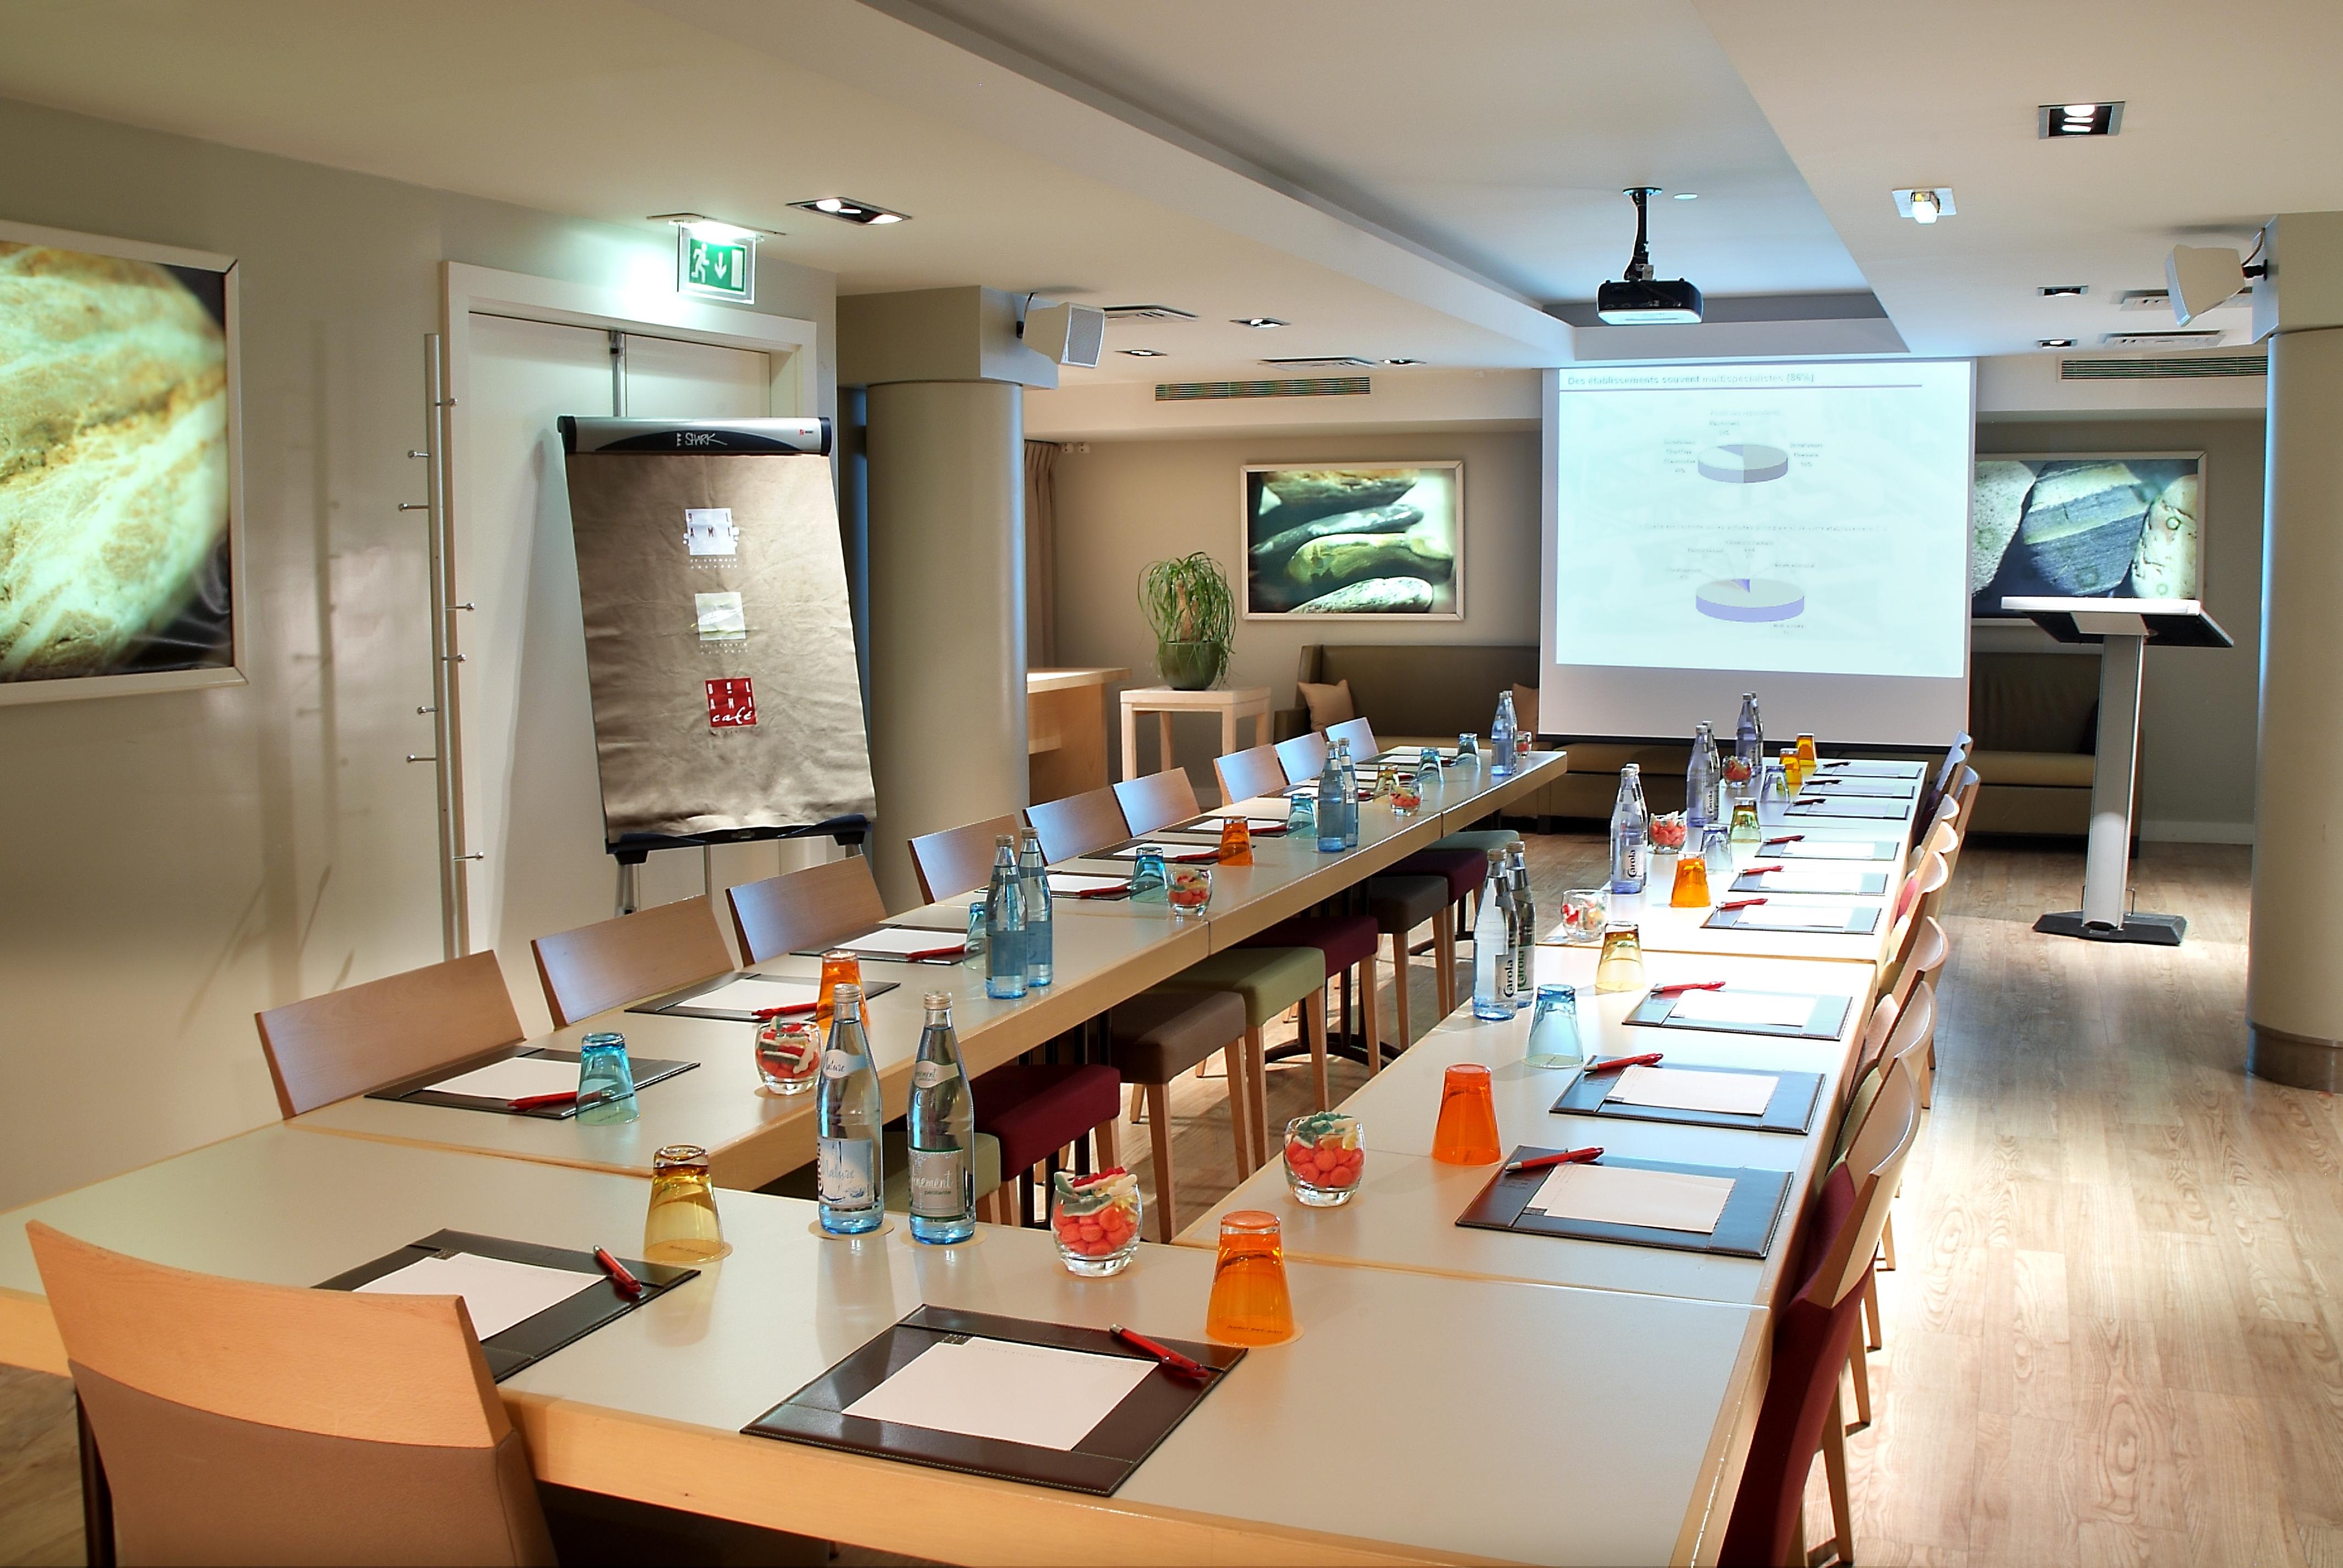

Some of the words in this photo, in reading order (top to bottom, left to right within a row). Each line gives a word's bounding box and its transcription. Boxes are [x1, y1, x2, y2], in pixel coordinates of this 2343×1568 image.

[1661, 374, 1699, 384] souvent
[1627, 850, 1637, 878] Carola
[1503, 960, 1514, 998] Carola
